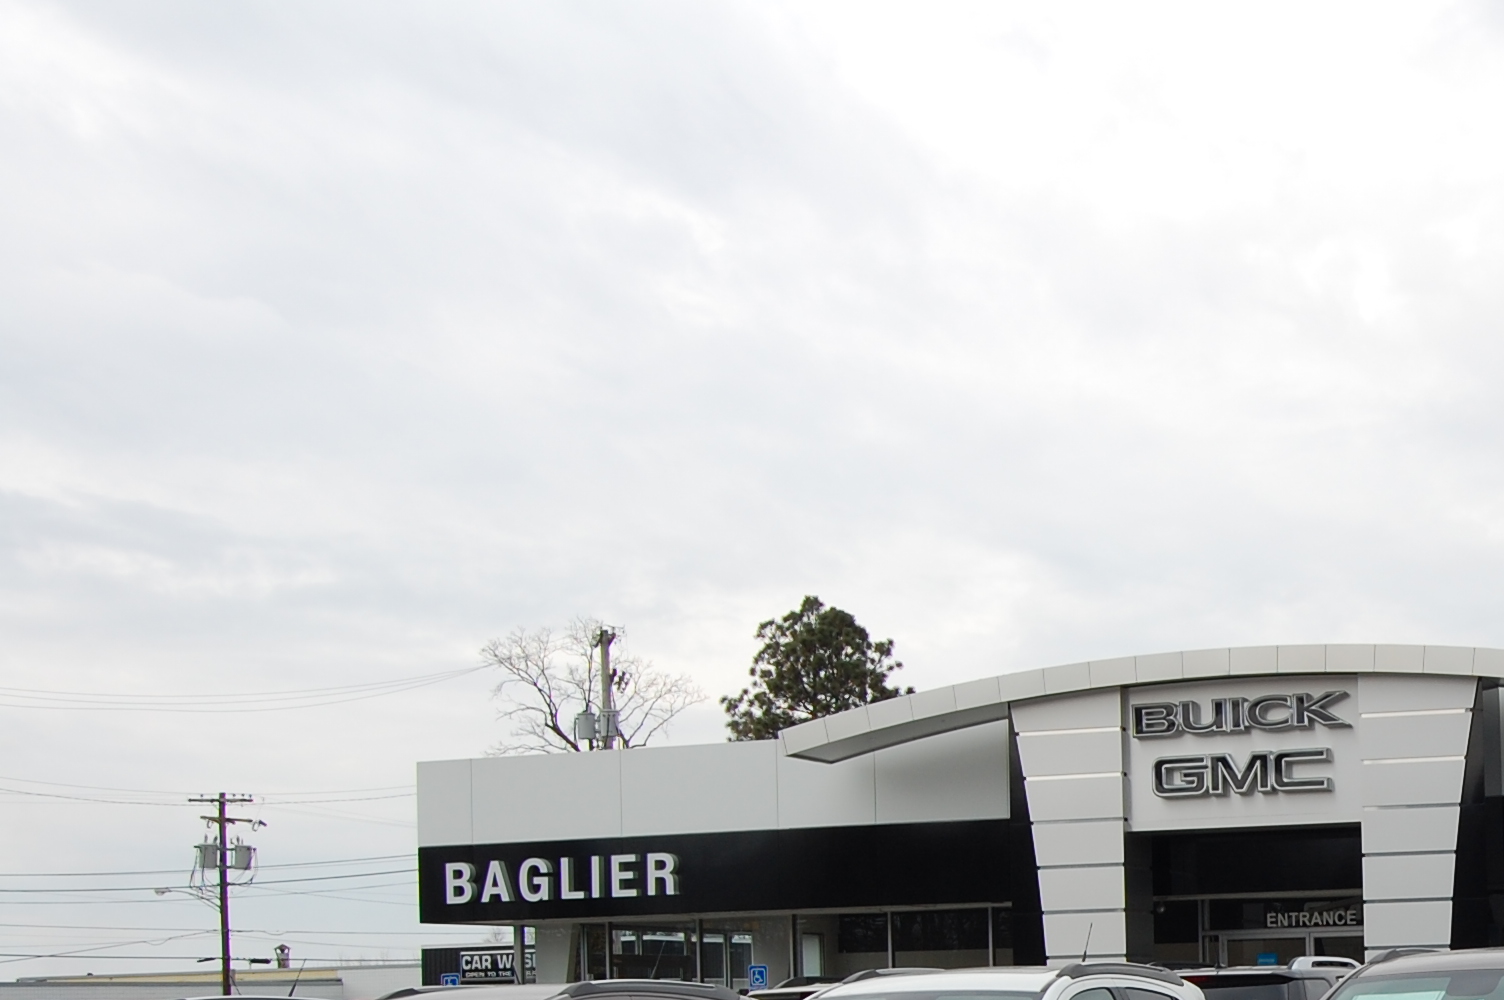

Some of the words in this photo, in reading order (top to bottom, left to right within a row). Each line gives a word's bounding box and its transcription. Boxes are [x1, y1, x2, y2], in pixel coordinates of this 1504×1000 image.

[1132, 690, 1353, 739] BUICK
[1152, 747, 1334, 797] GMC
[445, 852, 680, 904] BAGLIER
[1266, 910, 1357, 927] ENTRANCE
[462, 955, 492, 970] CAR
[497, 954, 536, 969] WS
